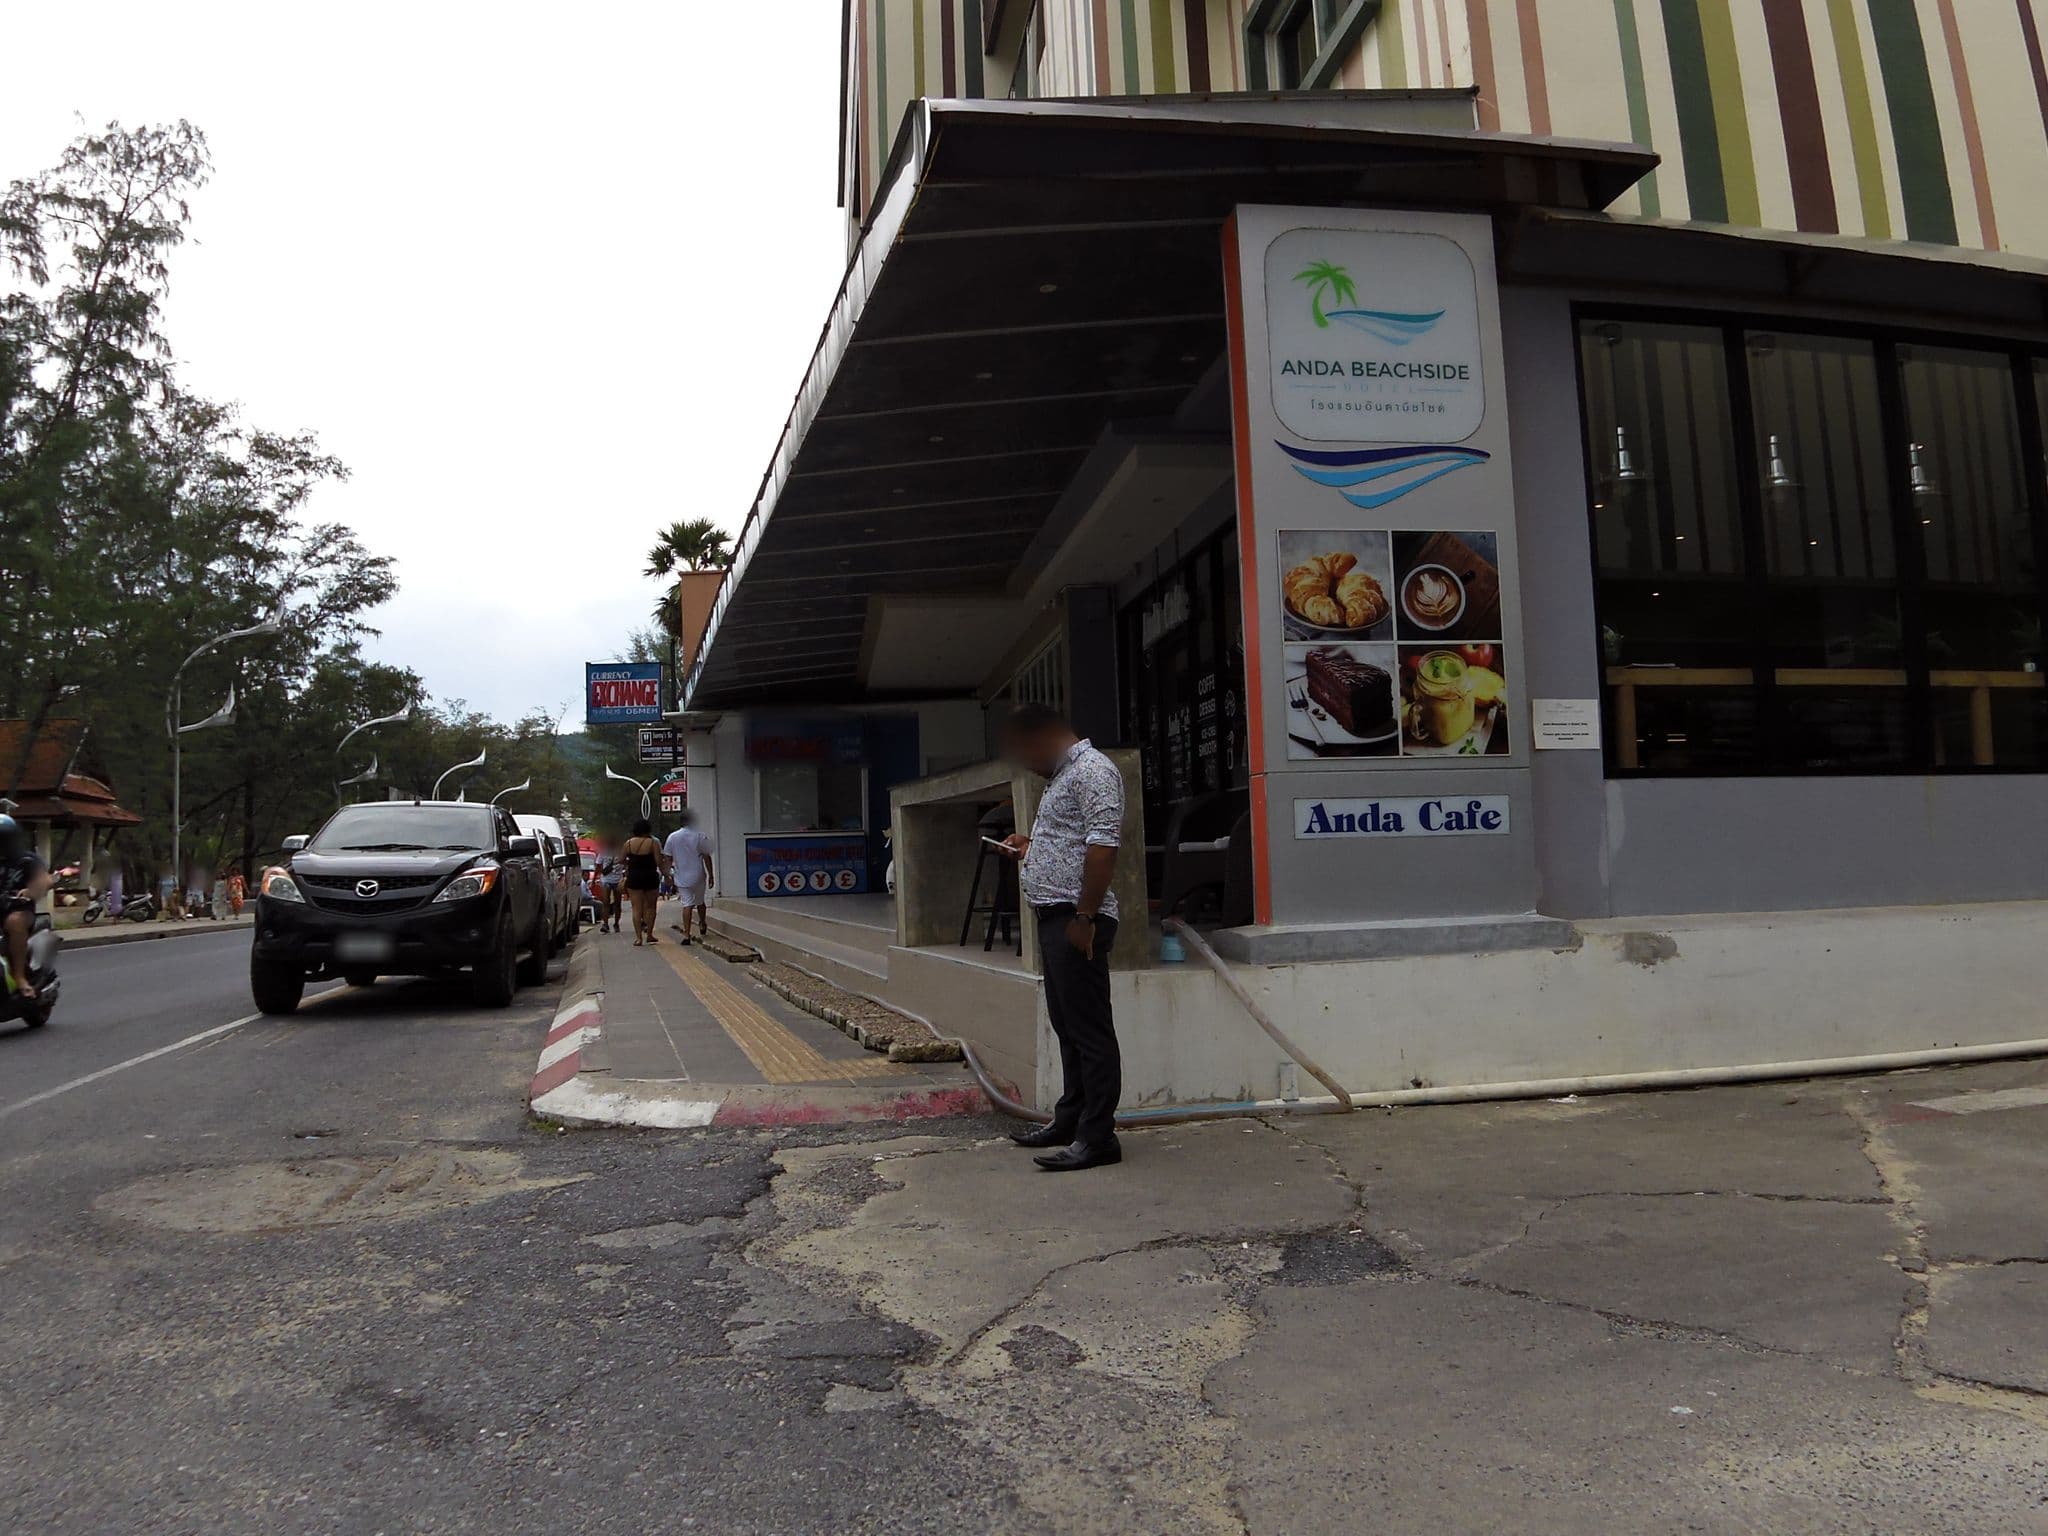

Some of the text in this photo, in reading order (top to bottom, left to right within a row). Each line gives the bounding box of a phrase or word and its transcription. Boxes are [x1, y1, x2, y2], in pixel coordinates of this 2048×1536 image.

[1281, 360, 1470, 380] ANDA BEACHSIDE
[591, 671, 632, 680] CURRENCY
[591, 680, 658, 708] EXCHANGE
[1303, 800, 1503, 834] Anda Cafe
